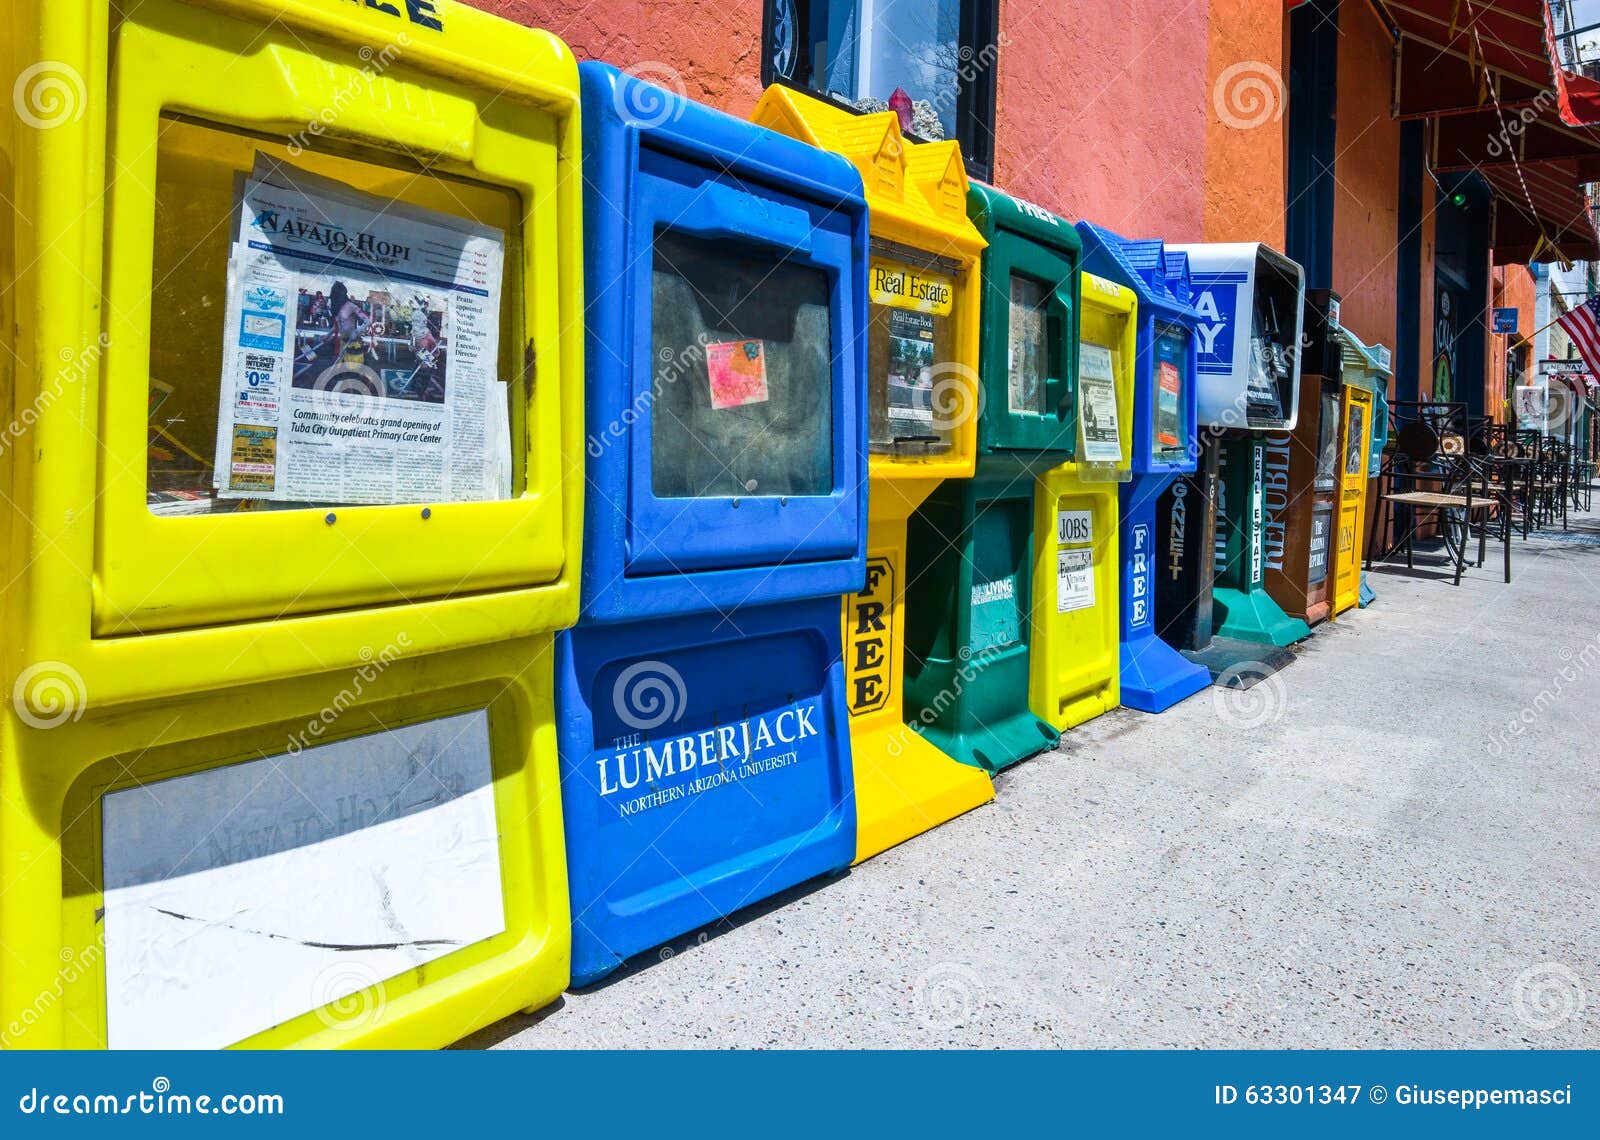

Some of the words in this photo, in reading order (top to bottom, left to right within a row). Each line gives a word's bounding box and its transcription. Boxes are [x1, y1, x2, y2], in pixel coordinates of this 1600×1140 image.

[1008, 194, 1059, 227] FREE
[875, 267, 905, 296] Real
[909, 275, 949, 304] Estate
[291, 422, 311, 433] Tuba
[312, 424, 327, 436] City
[328, 425, 371, 438] Outpatient
[372, 429, 402, 442] Primary
[402, 432, 419, 442] Care
[419, 434, 442, 444] Center
[293, 408, 341, 424] Community
[341, 413, 380, 426] celebrates
[380, 418, 402, 428] grand
[403, 421, 432, 432] opening
[432, 422, 441, 431] of
[1253, 447, 1262, 494] REAL
[1059, 517, 1089, 540] JOBS
[1169, 482, 1188, 580] GANNETT
[1252, 508, 1261, 581] ESTATE
[1132, 529, 1147, 622] FREE
[853, 564, 887, 709] FREE
[596, 705, 818, 796] LUMBERJACK
[612, 733, 641, 751] THE
[620, 782, 686, 817] NORTHERN
[687, 770, 738, 796] ARIZONA
[738, 751, 798, 778] UNIVERSITY
